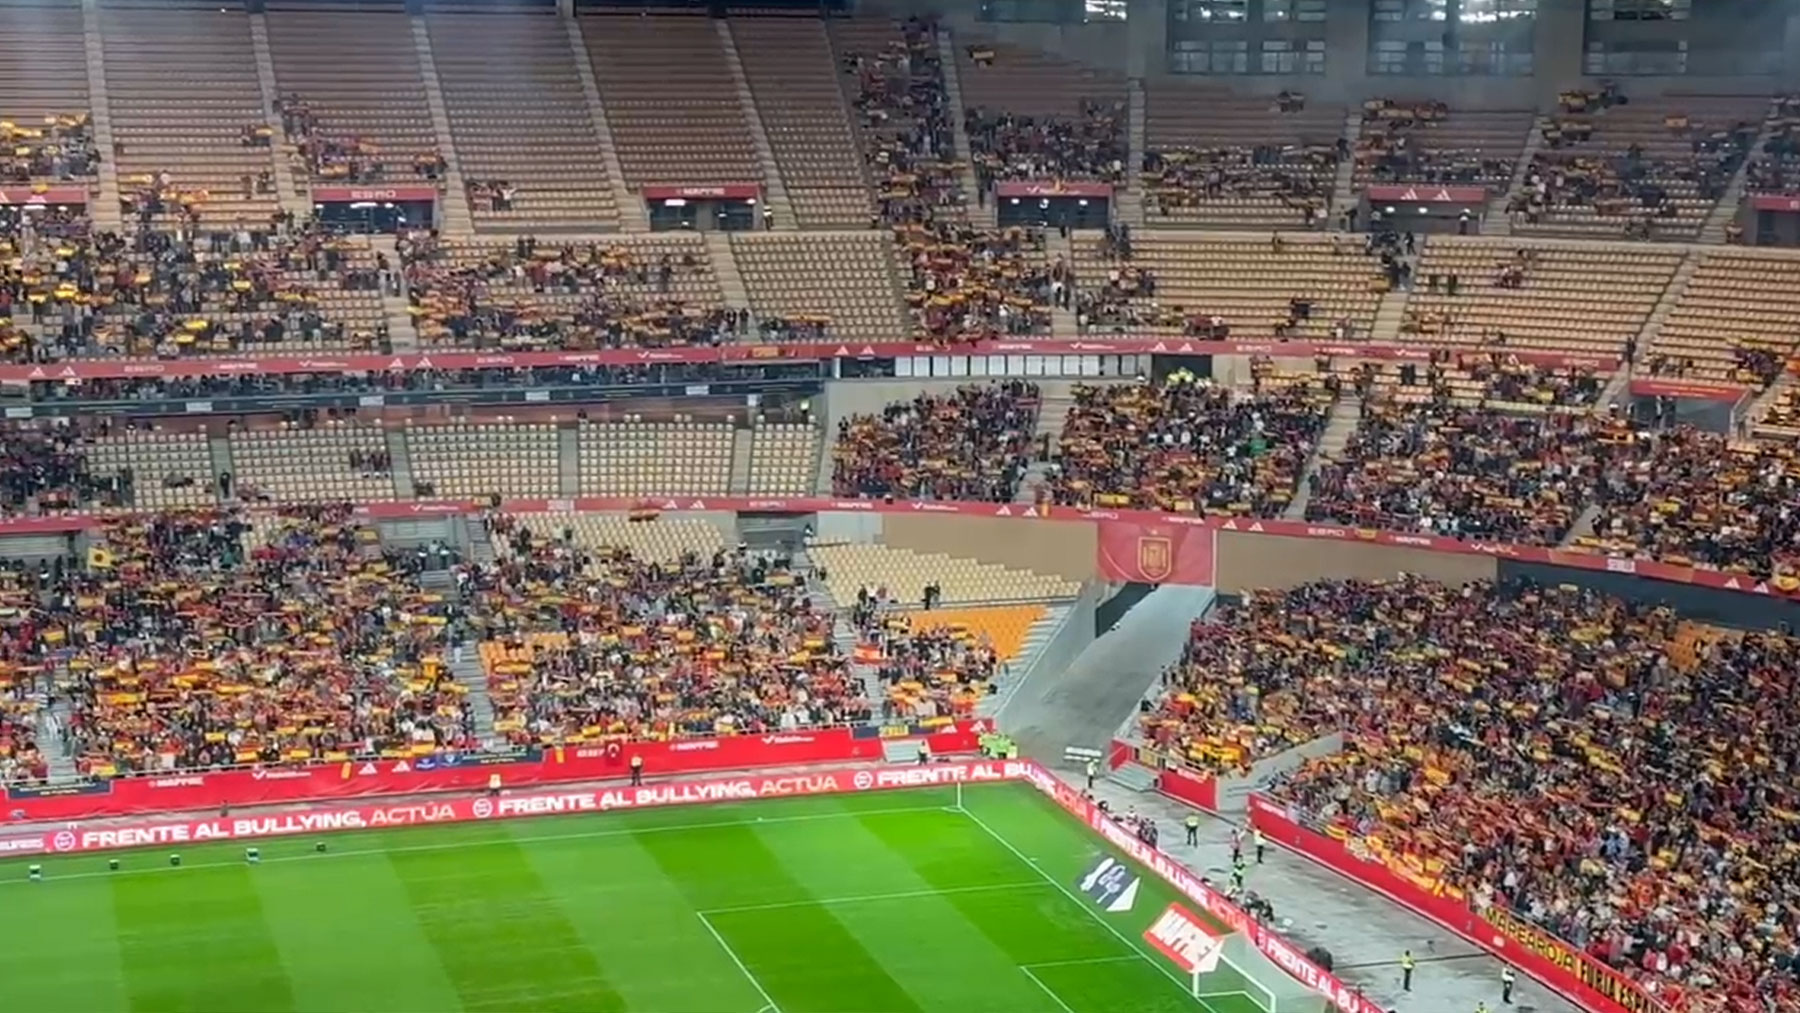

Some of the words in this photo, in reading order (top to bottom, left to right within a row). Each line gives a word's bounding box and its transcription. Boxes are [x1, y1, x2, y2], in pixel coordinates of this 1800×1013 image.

[970, 761, 1002, 780] AL
[498, 792, 597, 815] FRENTE
[599, 791, 632, 808] AL
[635, 780, 757, 805] BULLYING,
[82, 823, 190, 849] FRENTE
[192, 821, 231, 839] AL
[233, 810, 367, 836] BULLYING,
